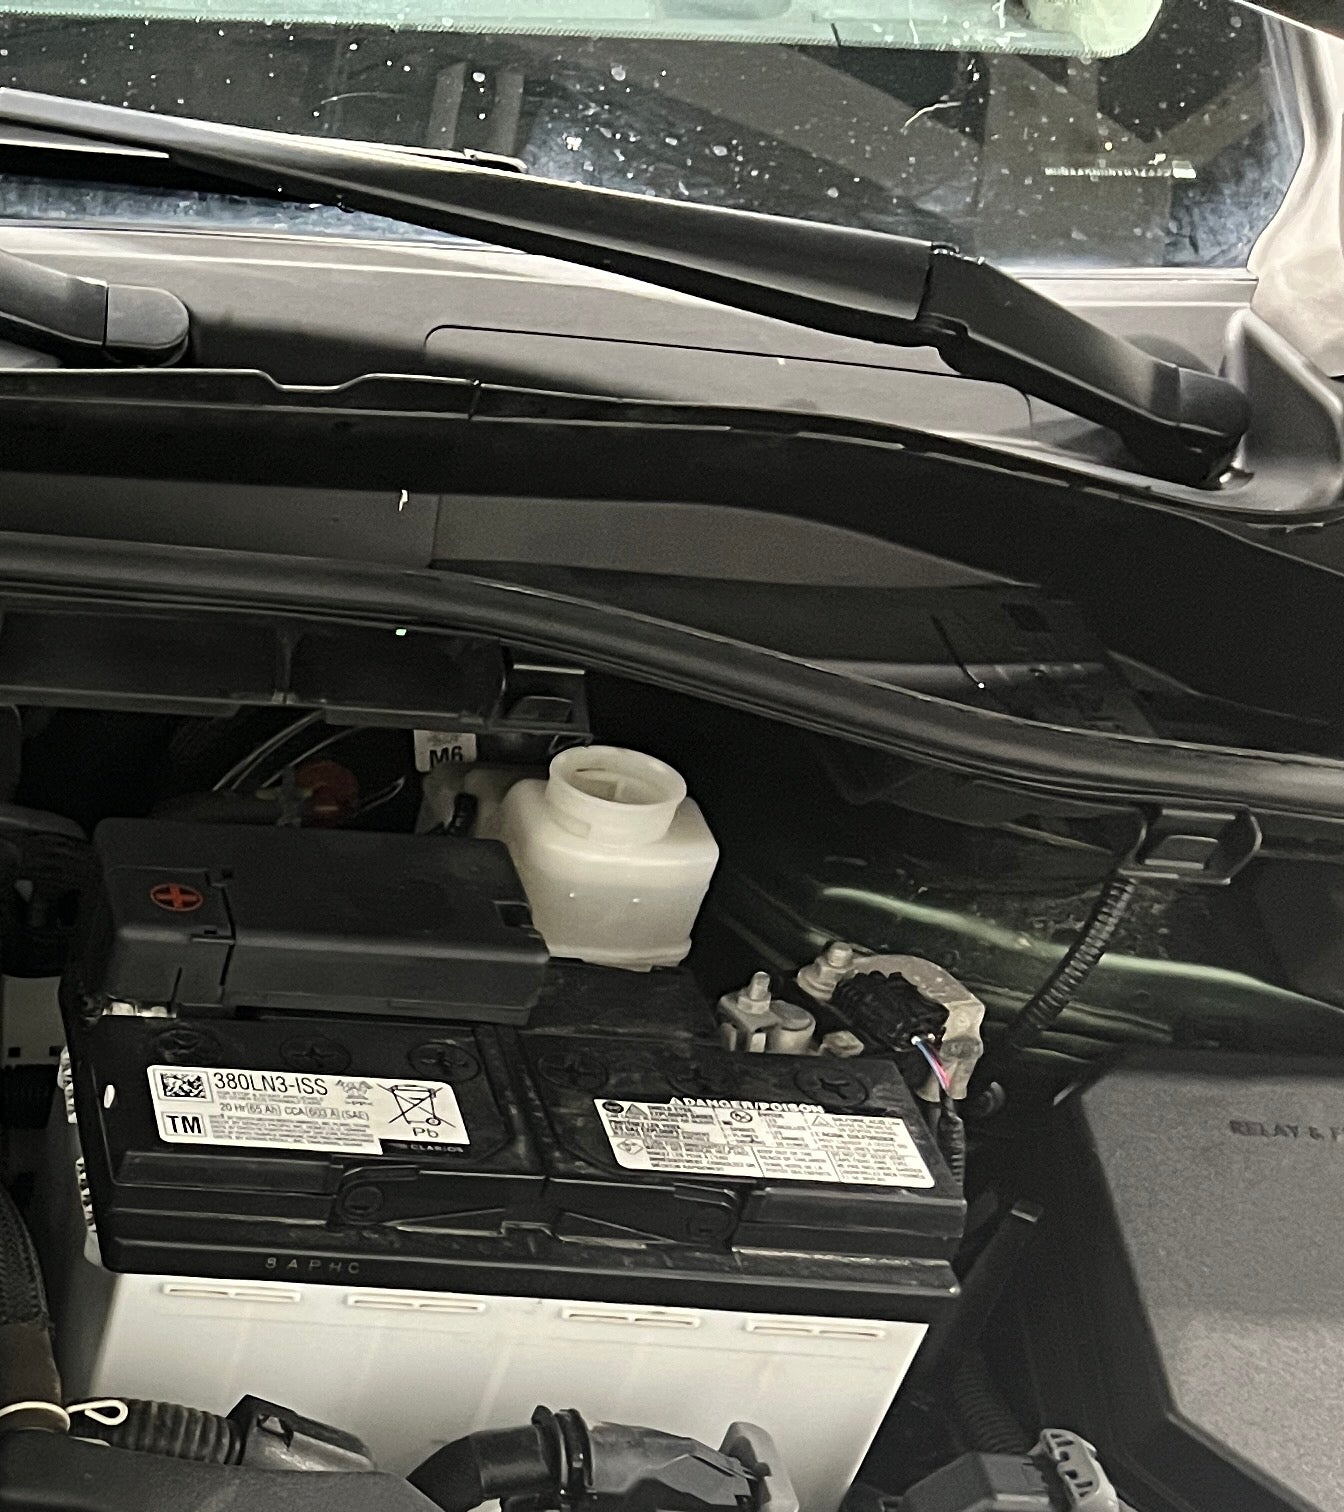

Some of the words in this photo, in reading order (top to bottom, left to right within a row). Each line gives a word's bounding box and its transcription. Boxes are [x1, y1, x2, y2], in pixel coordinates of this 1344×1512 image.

[213, 1072, 328, 1096] 380LN3-ISS
[166, 1115, 202, 1135] TM
[412, 1127, 439, 1138] Pb
